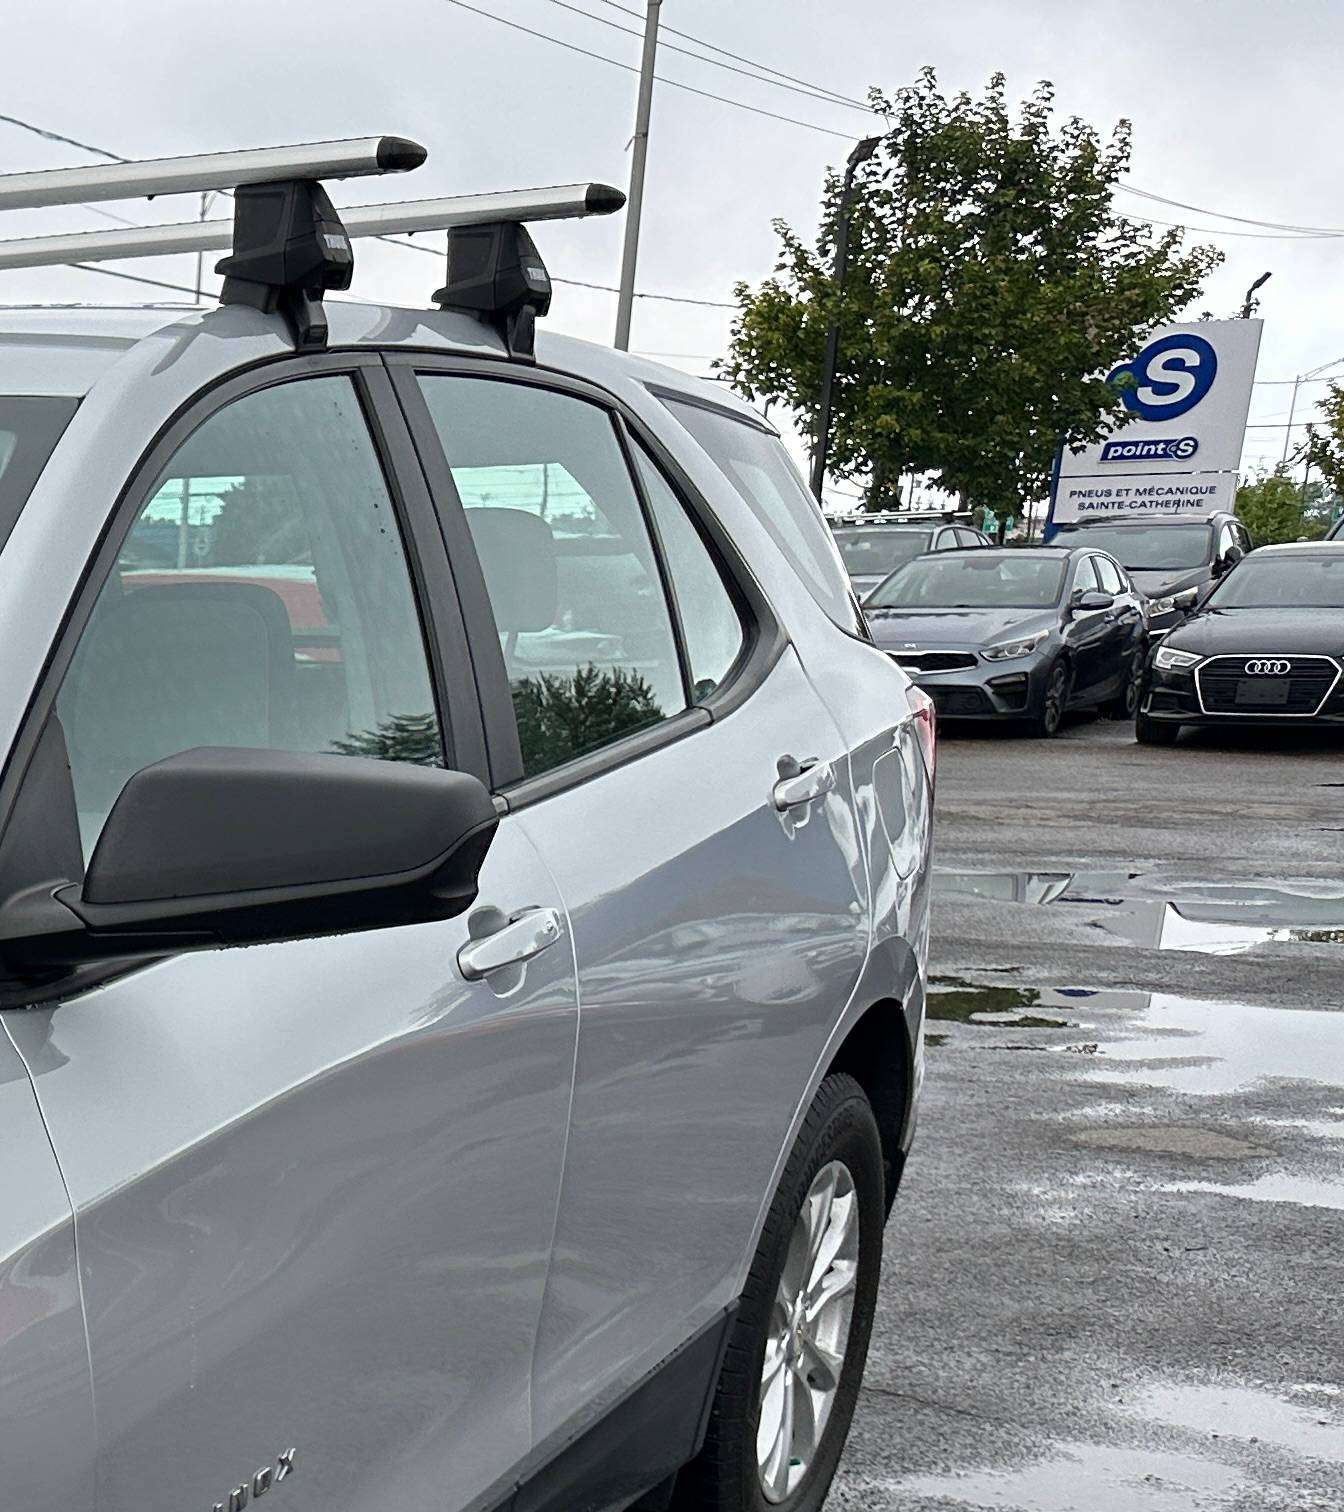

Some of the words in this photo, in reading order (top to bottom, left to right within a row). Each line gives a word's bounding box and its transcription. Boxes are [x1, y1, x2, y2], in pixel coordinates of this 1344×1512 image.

[1137, 348, 1201, 406] S
[1106, 442, 1165, 459] point
[1069, 489, 1113, 498] PNEUS
[1115, 488, 1132, 497] ET
[1135, 485, 1217, 497] MÉCANIQUE
[1077, 499, 1204, 511] SAINTE-CATHERINE
